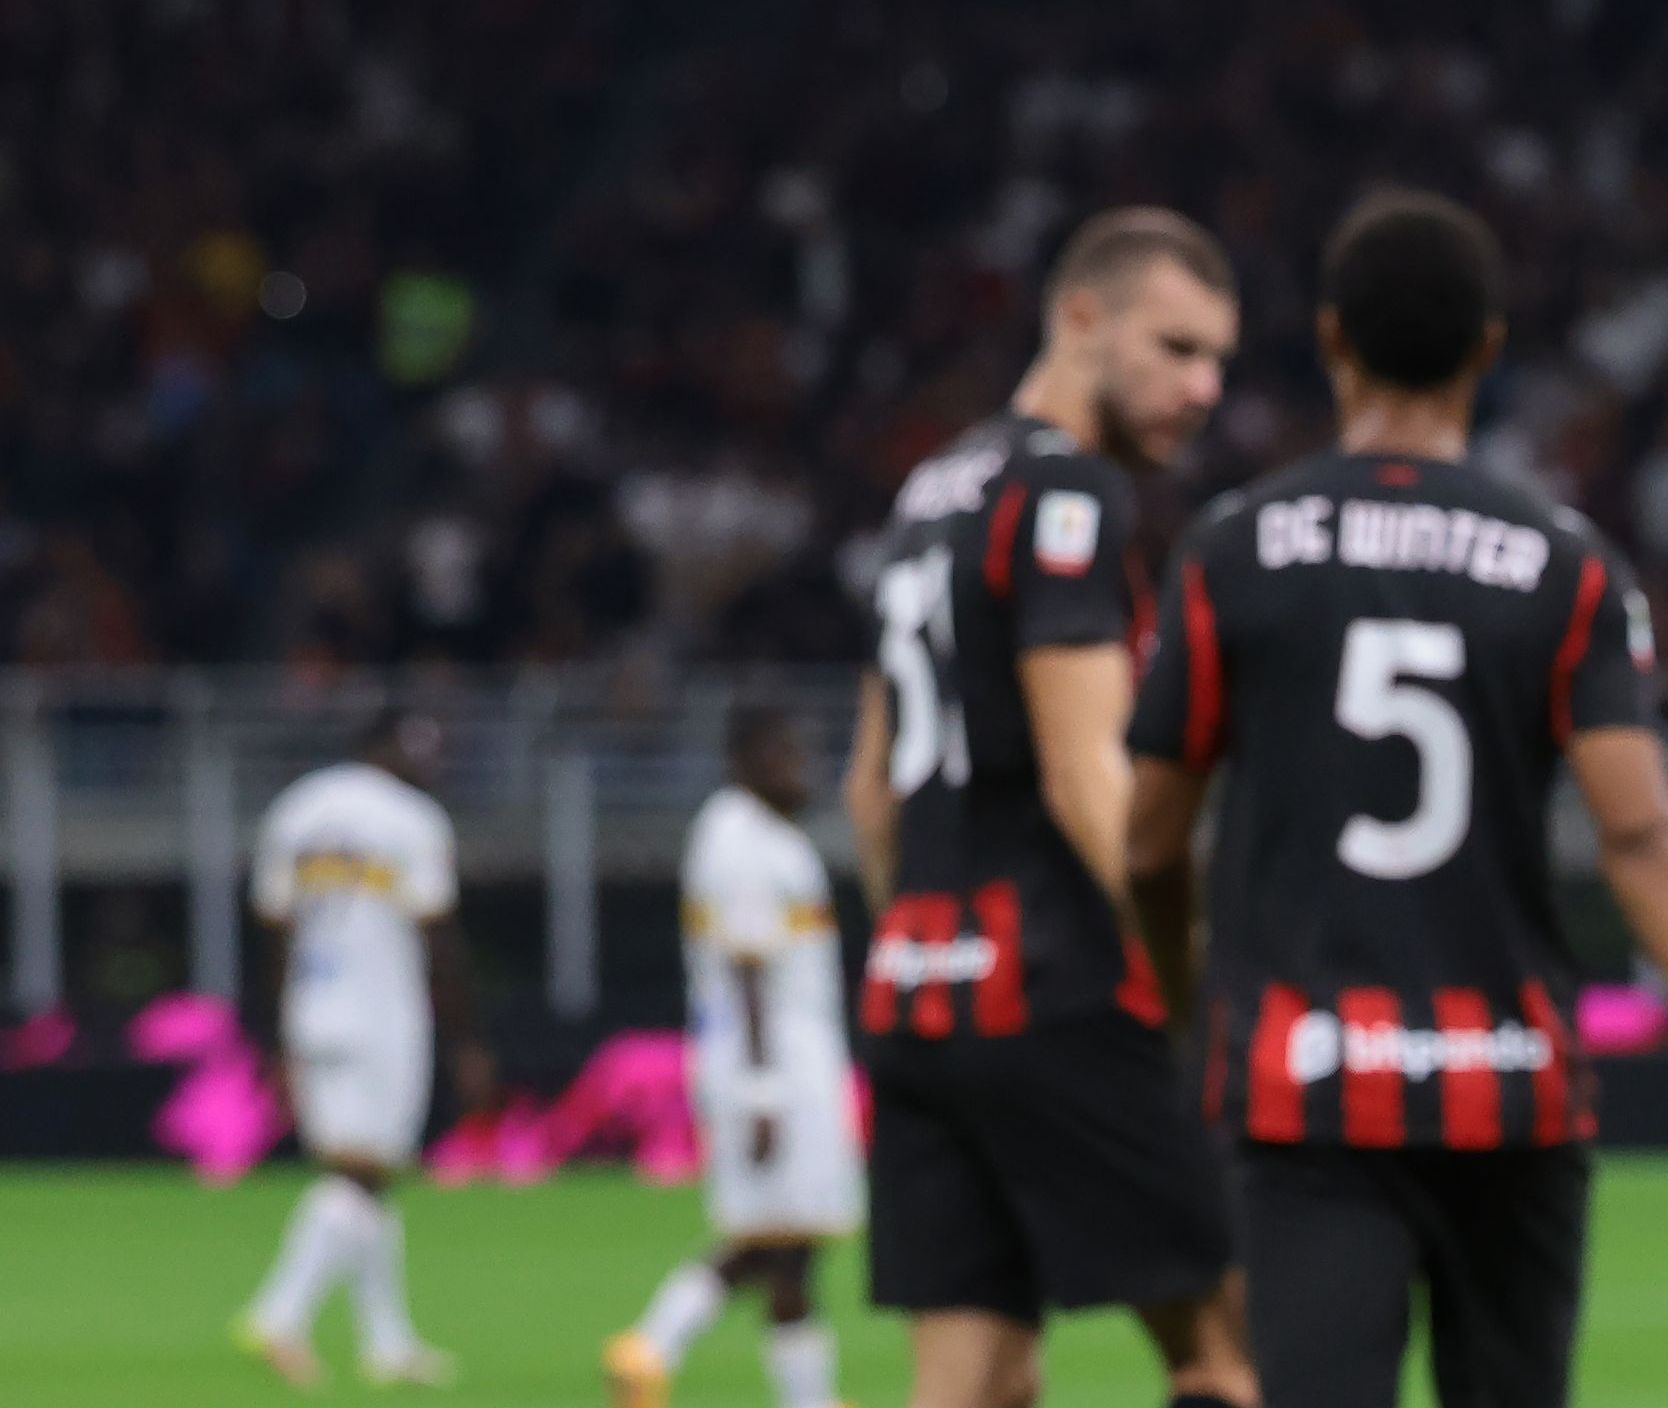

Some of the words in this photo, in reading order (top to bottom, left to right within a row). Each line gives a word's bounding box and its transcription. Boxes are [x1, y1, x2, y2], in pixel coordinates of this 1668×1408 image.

[1256, 495, 1334, 569] DE
[1339, 499, 1549, 592] WINTER
[1335, 617, 1473, 880] 5
